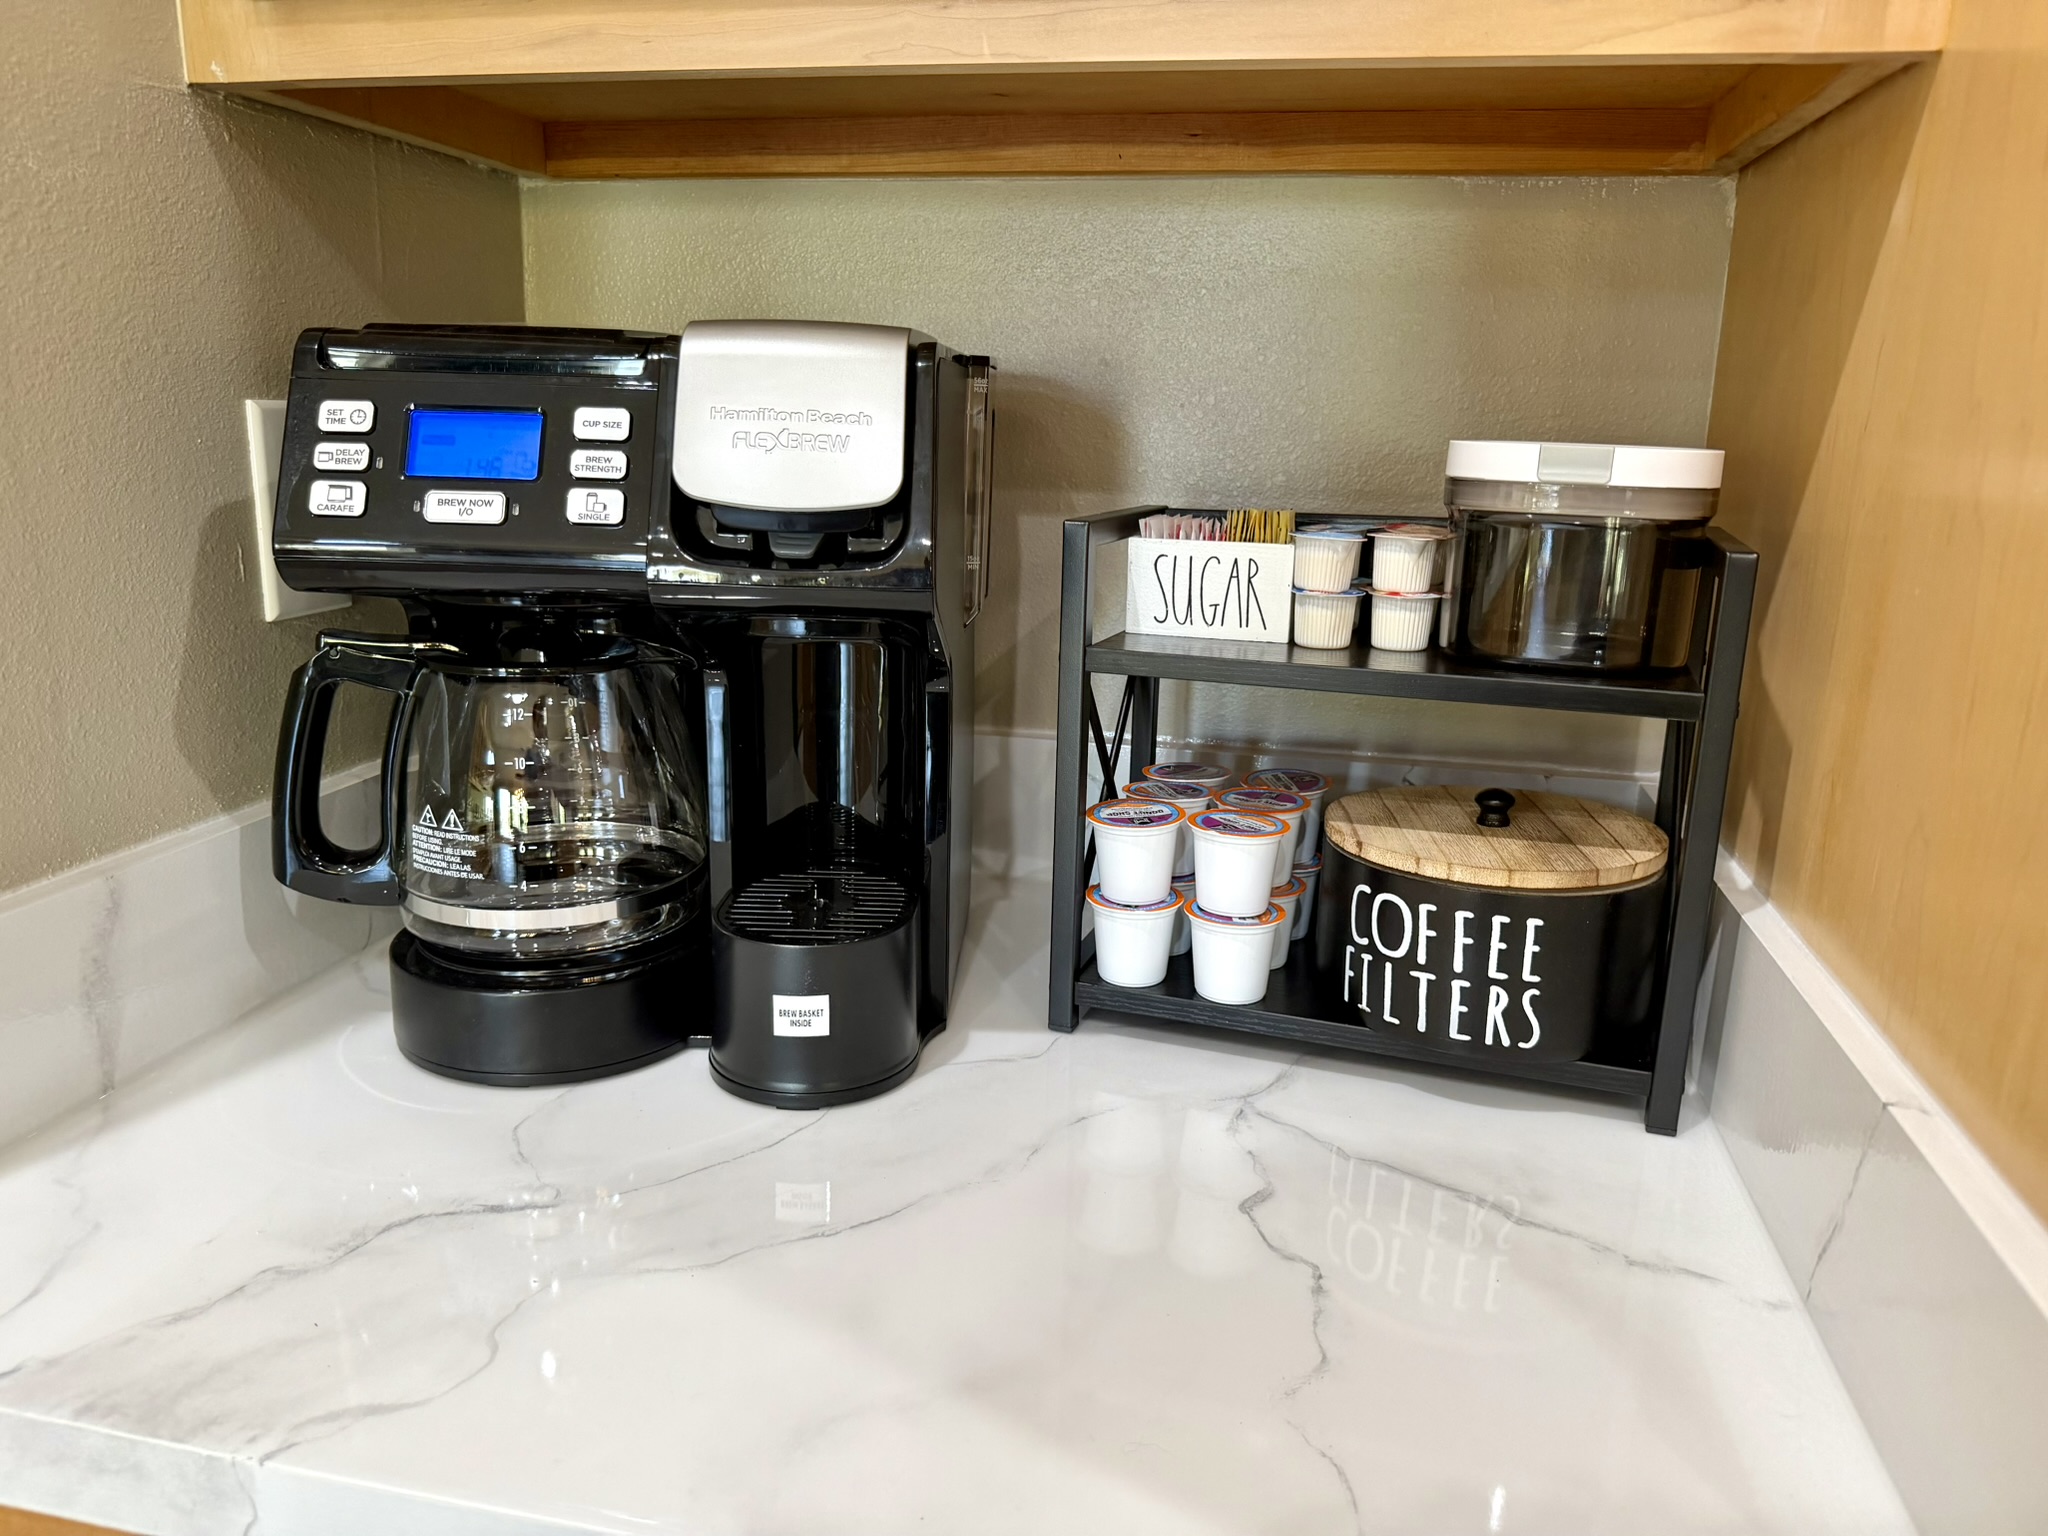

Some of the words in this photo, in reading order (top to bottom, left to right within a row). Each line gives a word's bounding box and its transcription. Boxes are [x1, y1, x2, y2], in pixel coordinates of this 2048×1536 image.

[326, 408, 344, 416] SET
[710, 406, 804, 422] Hamilton
[806, 409, 873, 426] Beach
[325, 417, 347, 425] TIME
[582, 420, 601, 428] CUP
[602, 421, 623, 429] SIZE
[335, 448, 365, 457] DELAY
[334, 457, 362, 465] BREW
[585, 456, 613, 464] BREW
[574, 464, 622, 474] STRENGTH
[316, 503, 355, 513] CARAFE
[437, 498, 467, 507] BREW
[469, 499, 495, 508] NOW
[458, 507, 474, 517] I/O
[577, 513, 610, 522] SINGLE
[1153, 554, 1267, 630] SUGAR
[512, 708, 524, 720] 12
[514, 757, 526, 770] 10
[412, 824, 434, 836] CAUTION:
[434, 830, 446, 838] READ
[446, 832, 480, 842] INSTRUCTIONS
[412, 832, 428, 842] BEFORE
[412, 839, 442, 852] ATTENTION:
[519, 842, 526, 853] 6
[460, 864, 471, 872] LAS
[443, 869, 460, 878] ANTES
[468, 872, 485, 880] USAR.
[520, 880, 527, 892] 4
[1351, 884, 1544, 983] COFFEE
[1344, 944, 1541, 1049] FILTERS
[778, 1008, 798, 1018] BREW
[798, 1008, 824, 1018] BASKET
[789, 1018, 812, 1027] INSIDE
